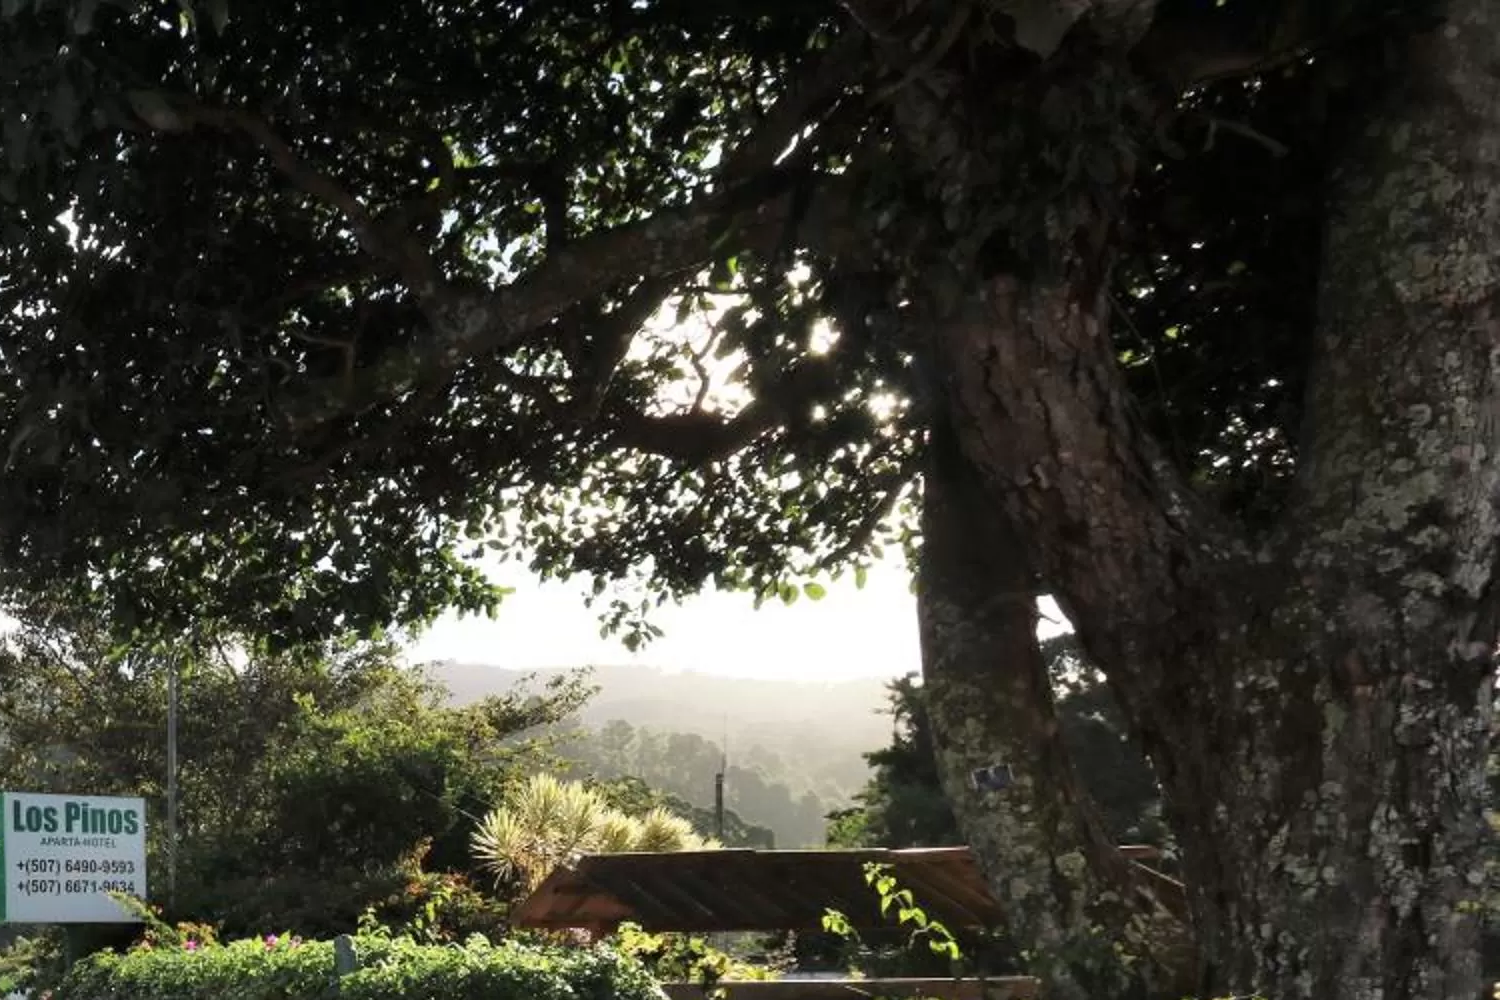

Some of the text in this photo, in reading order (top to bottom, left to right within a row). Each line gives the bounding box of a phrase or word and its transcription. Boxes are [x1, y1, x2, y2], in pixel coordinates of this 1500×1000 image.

[13, 800, 139, 835] Los Pinos
[16, 859, 61, 875] +(507)
[16, 879, 61, 896] +(507)
